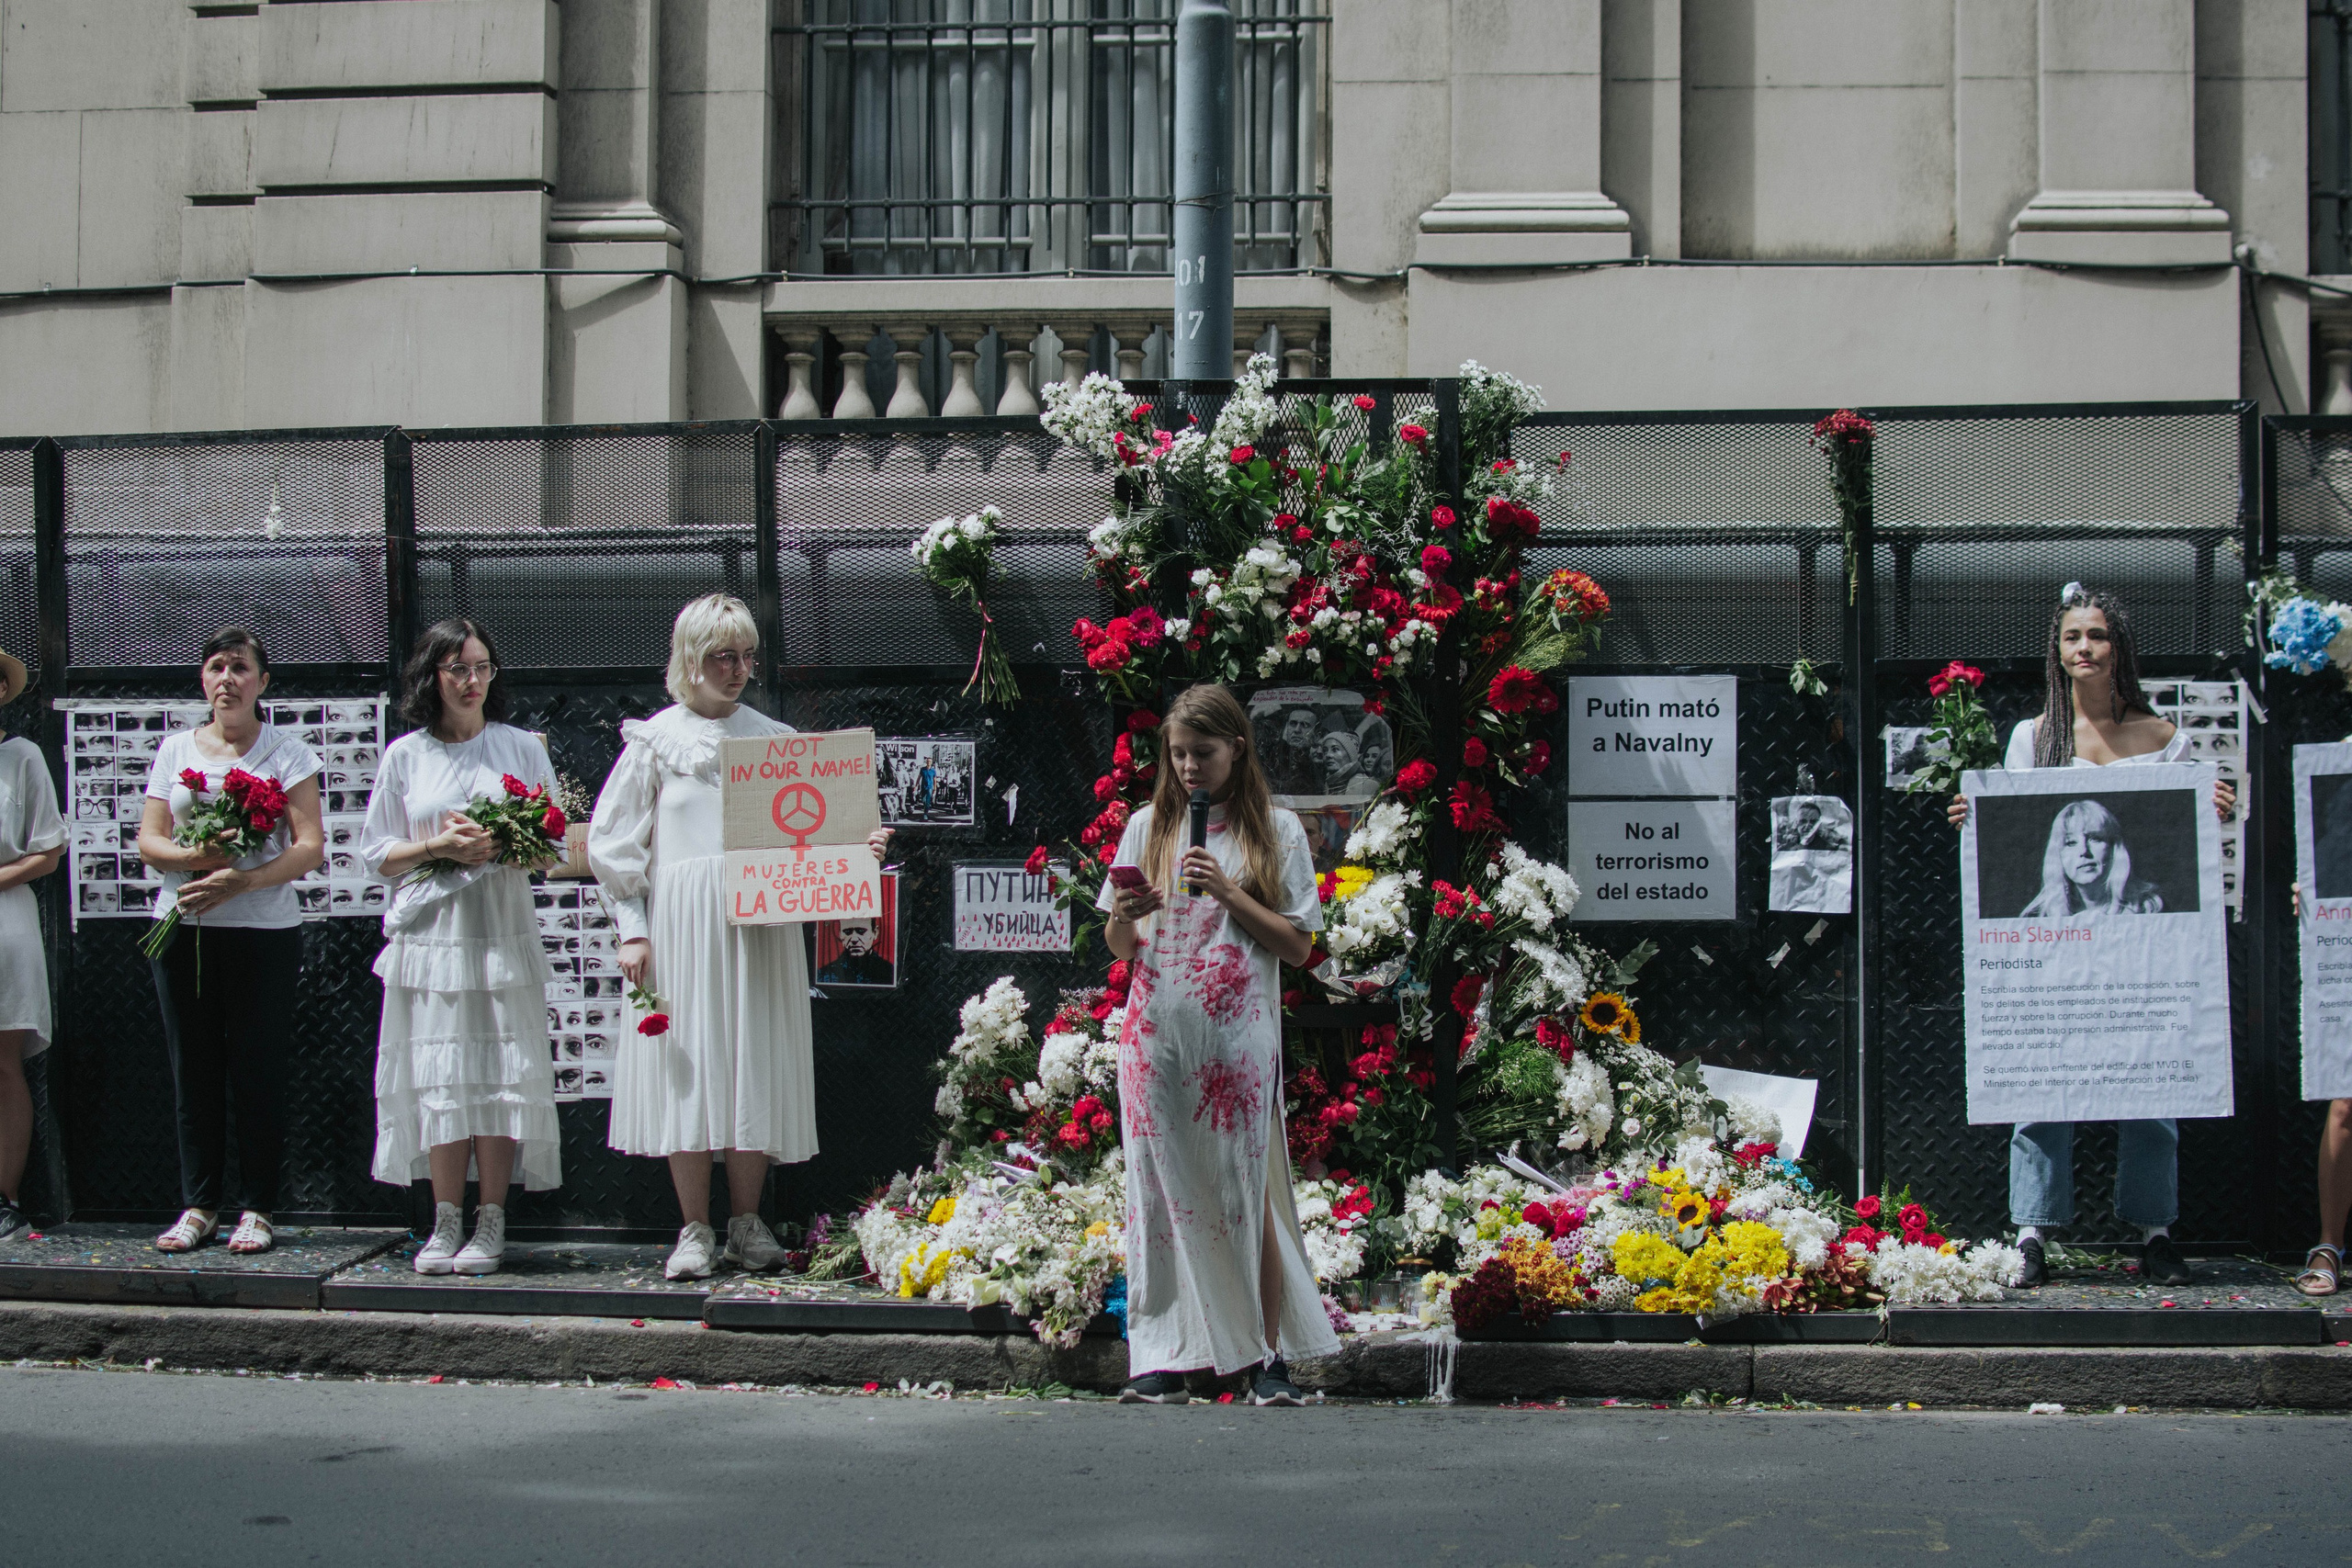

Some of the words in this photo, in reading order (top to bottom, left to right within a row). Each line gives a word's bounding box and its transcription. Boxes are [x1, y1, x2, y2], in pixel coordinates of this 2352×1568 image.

[1177, 310, 1204, 341] 17
[1587, 697, 1650, 718] Putin
[1659, 697, 1720, 718] mató
[767, 738, 824, 760] NOT
[1592, 737, 1606, 752] a
[1615, 732, 1713, 758] Navalny
[731, 763, 754, 784] IN
[759, 761, 802, 780] OUR
[811, 754, 870, 778] NAME!
[1625, 822, 1655, 840] No
[1661, 822, 1679, 840] al
[743, 858, 849, 880] MUJERES
[1596, 852, 1709, 870] terrorismo
[772, 875, 826, 889] CONTRA
[967, 871, 1052, 903] ПУТИН
[1597, 883, 1628, 899] del
[1635, 882, 1709, 899] estado
[736, 890, 767, 918] LA
[778, 880, 874, 913] GUERRA
[983, 910, 1057, 937] УБИЙЦА
[1980, 928, 2020, 943] Irina
[2027, 926, 2092, 942] Slavina
[1980, 958, 2042, 970] Periodista
[2019, 985, 2044, 993] sobre
[2047, 983, 2100, 994] persecución
[2103, 983, 2114, 991] de
[2117, 982, 2125, 990] la
[2318, 976, 2342, 986] lucha
[1981, 1000, 1995, 1009] los
[1996, 999, 2026, 1009] delitos
[2029, 998, 2040, 1007] de
[2041, 998, 2054, 1007] los
[2057, 998, 2106, 1007] empleados
[2109, 997, 2120, 1005] de
[2122, 995, 2177, 1004] instituciones
[2179, 995, 2191, 1003] de
[1981, 1014, 2009, 1022] fuerza
[2012, 1015, 2018, 1023] y
[2019, 1013, 2045, 1021] sobre
[2058, 1011, 2107, 1021] corrupción.
[2109, 1010, 2145, 1019] Durante
[2148, 1010, 2178, 1018] mucho
[1982, 1029, 2012, 1038] tiempo
[2014, 1027, 2045, 1036] estaba
[2047, 1027, 2066, 1036] bajo
[2068, 1025, 2101, 1035] presión
[2104, 1023, 2168, 1033] administrativa.
[2171, 1022, 2188, 1031] Fue
[1982, 1042, 2014, 1051] llevada
[2017, 1042, 2024, 1050] al
[1984, 1066, 1996, 1074] Se
[1998, 1065, 2029, 1075] quemó
[2031, 1064, 2049, 1073] viva
[2052, 1064, 2088, 1072] enfrente
[2091, 1062, 2104, 1071] del
[2107, 1062, 2139, 1071] edificio
[2141, 1061, 2154, 1070] del
[2156, 1060, 2179, 1069] MVD
[1984, 1078, 2027, 1089] Ministerio
[2029, 1078, 2042, 1087] del
[2045, 1077, 2076, 1087] Interior
[2078, 1077, 2089, 1086] de
[2092, 1077, 2100, 1085] la
[2103, 1075, 2153, 1085] Federación
[2155, 1075, 2166, 1083] de
